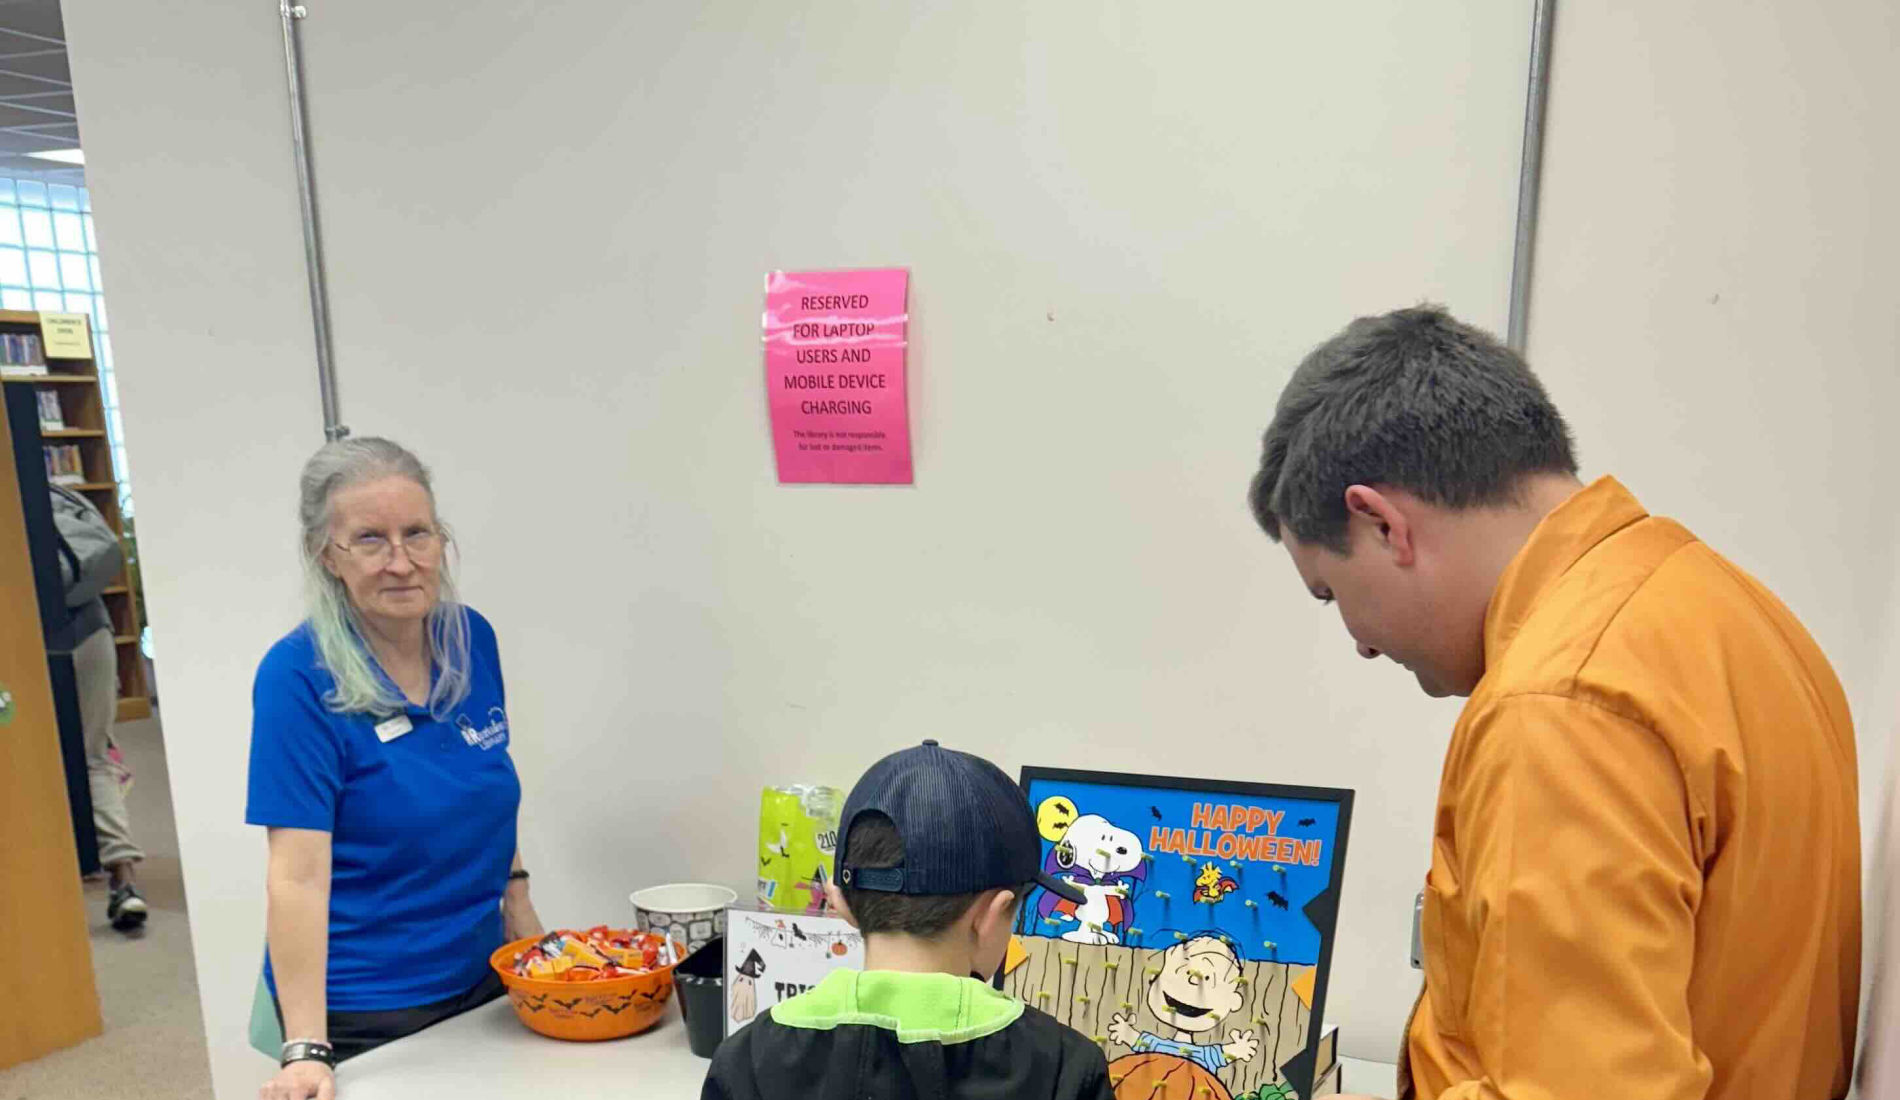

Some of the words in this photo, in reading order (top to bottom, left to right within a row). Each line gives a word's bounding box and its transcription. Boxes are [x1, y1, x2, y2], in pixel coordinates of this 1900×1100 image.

[801, 294, 869, 310] RESERVED
[793, 323, 819, 338] FOR
[823, 322, 875, 338] LAPTOP
[796, 349, 838, 364] USERS
[841, 348, 871, 363] AND
[784, 374, 835, 389] MOBILE
[839, 374, 886, 389] DEVICE
[801, 400, 872, 415] CHARGING
[1191, 802, 1285, 835] HAPPY
[817, 830, 837, 849] 210
[1149, 826, 1322, 866] HALLOWEEN!
